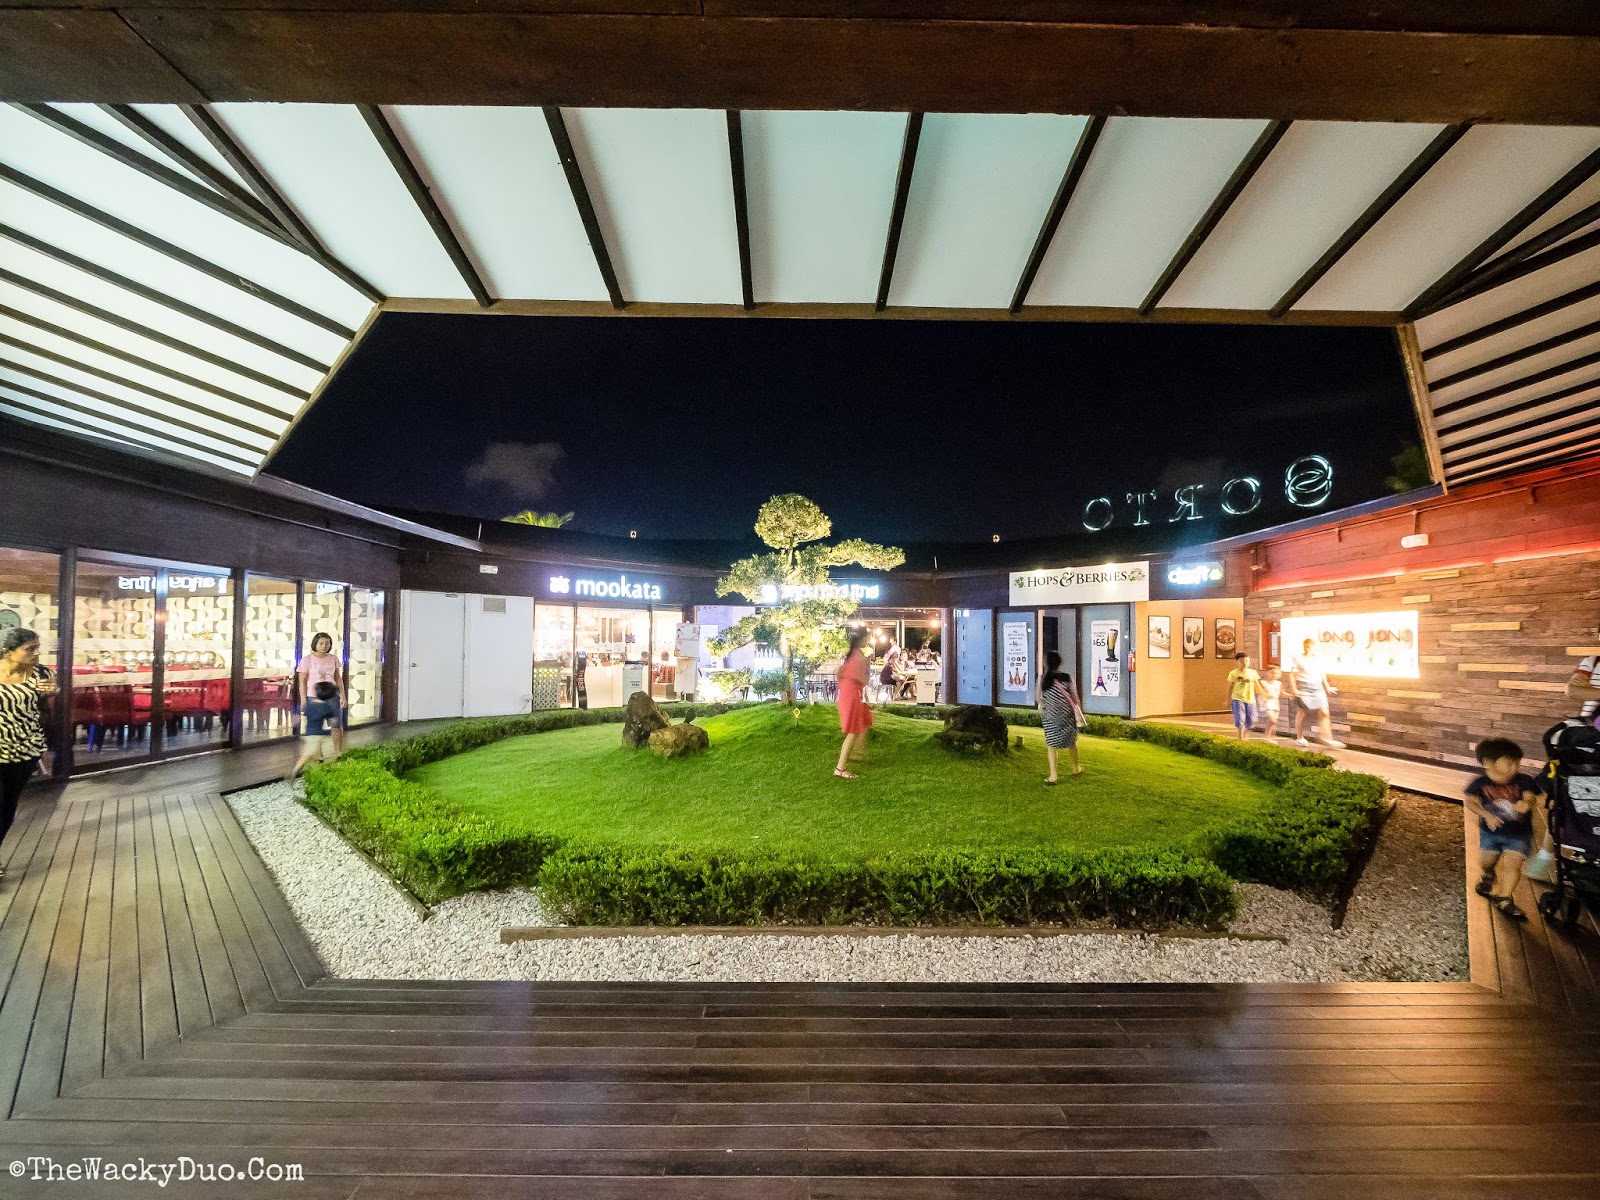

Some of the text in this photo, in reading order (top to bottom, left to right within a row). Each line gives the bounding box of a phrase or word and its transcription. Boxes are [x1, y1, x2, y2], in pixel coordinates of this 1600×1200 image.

[575, 574, 662, 600] mookata
[1027, 575, 1059, 588] HOPS
[1076, 570, 1128, 585] BERRIES
